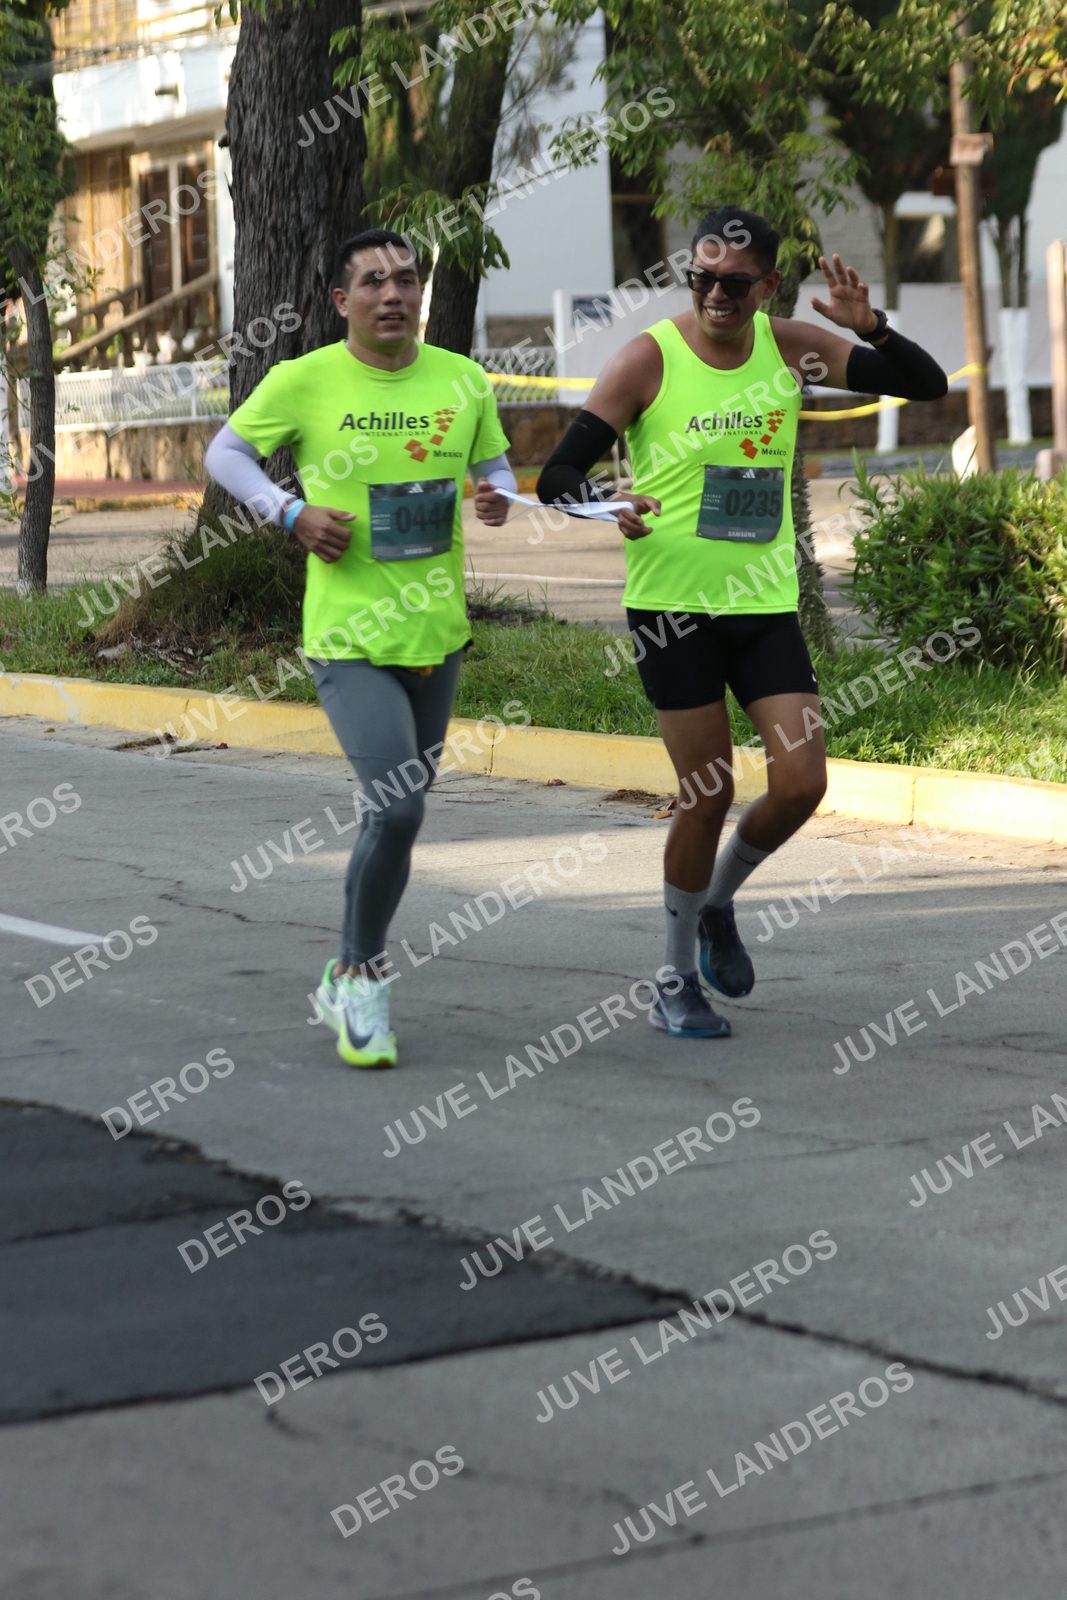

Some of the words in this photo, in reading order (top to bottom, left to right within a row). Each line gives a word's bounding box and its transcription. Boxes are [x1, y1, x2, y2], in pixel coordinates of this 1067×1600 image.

[338, 411, 430, 431] Achilles
[684, 411, 763, 433] Achilles
[725, 488, 781, 518] 0235
